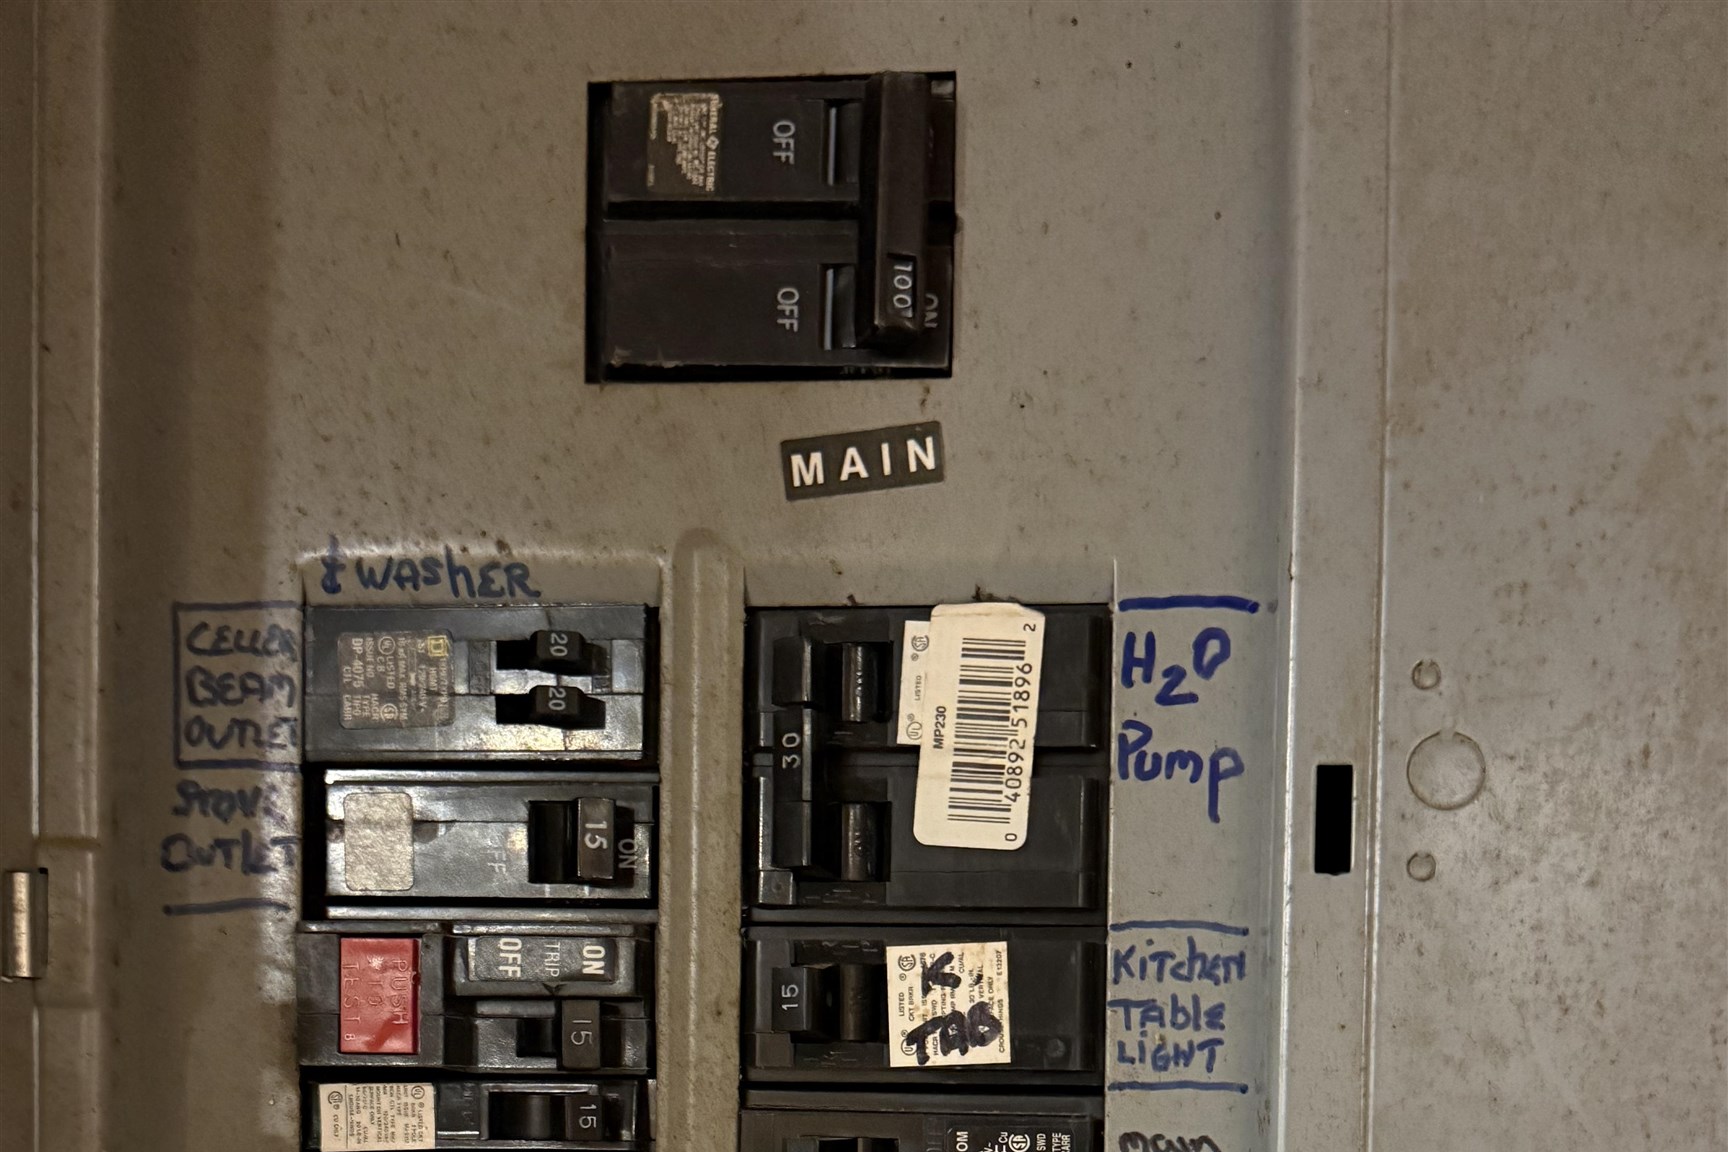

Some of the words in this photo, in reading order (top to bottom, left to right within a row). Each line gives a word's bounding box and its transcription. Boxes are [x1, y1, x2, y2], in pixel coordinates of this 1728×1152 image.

[772, 120, 795, 165] OFF
[706, 151, 716, 191] ELECTRIC
[892, 262, 913, 311] 100
[777, 287, 799, 333] OFF
[924, 292, 938, 328] ON
[790, 435, 936, 488] MAIN
[1023, 623, 1036, 632] 2
[352, 638, 363, 688] DP-4075
[550, 633, 568, 659] 20
[387, 656, 395, 689] LISTED
[1121, 627, 1231, 706] H2O
[186, 665, 297, 707] BEAM
[547, 688, 567, 713] 20
[914, 675, 922, 701] LISTED
[1011, 663, 1033, 728] 51896
[933, 706, 947, 749] MP230
[781, 731, 800, 770] 30
[1004, 738, 1026, 803] 40892
[585, 819, 608, 851] 15
[1004, 833, 1018, 842] 0
[618, 839, 637, 870] ON
[498, 938, 522, 977] OFF
[544, 942, 560, 977] TRIP
[583, 945, 605, 975] ON
[392, 960, 408, 1025] PUSH
[782, 983, 799, 1011] 15
[571, 1019, 593, 1045] 15
[579, 1103, 597, 1129] 15
[998, 1131, 1008, 1144] Cu
[1037, 1133, 1046, 1152] SWD
[1052, 1132, 1061, 1152] TYPE
